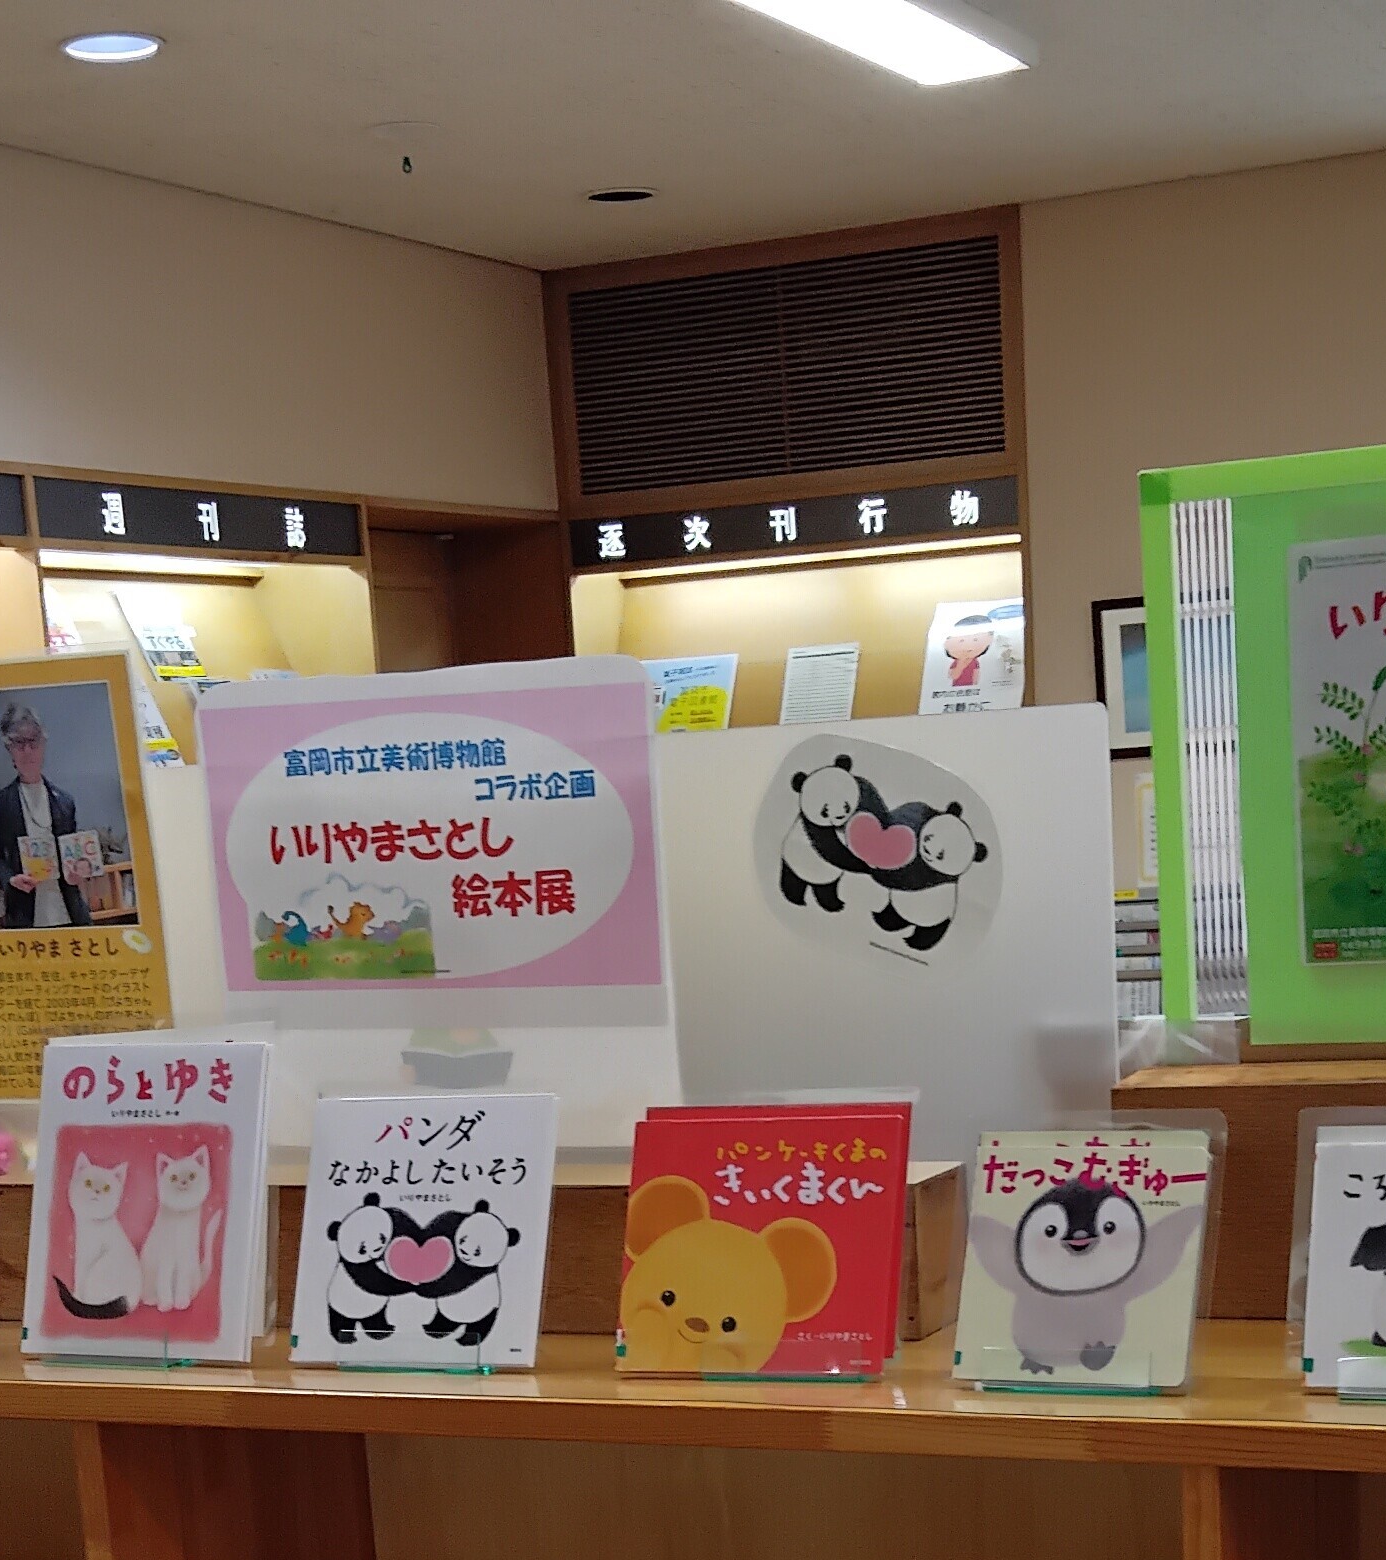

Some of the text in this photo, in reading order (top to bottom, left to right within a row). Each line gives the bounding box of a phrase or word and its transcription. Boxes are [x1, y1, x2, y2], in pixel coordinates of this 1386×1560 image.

[597, 489, 981, 560] 逐次刊行物
[284, 738, 507, 777] 富岡市立美術博物館
[474, 769, 596, 801] コラボ企画
[269, 817, 514, 865] いりやまさとし
[451, 868, 576, 919] 絵本展
[69, 937, 119, 958] さとし
[62, 1055, 235, 1105] のらとゆき
[375, 1109, 487, 1151] パンダ
[328, 1158, 527, 1188] なかよしたいそう
[983, 1150, 1208, 1198] だっこむぎゅー
